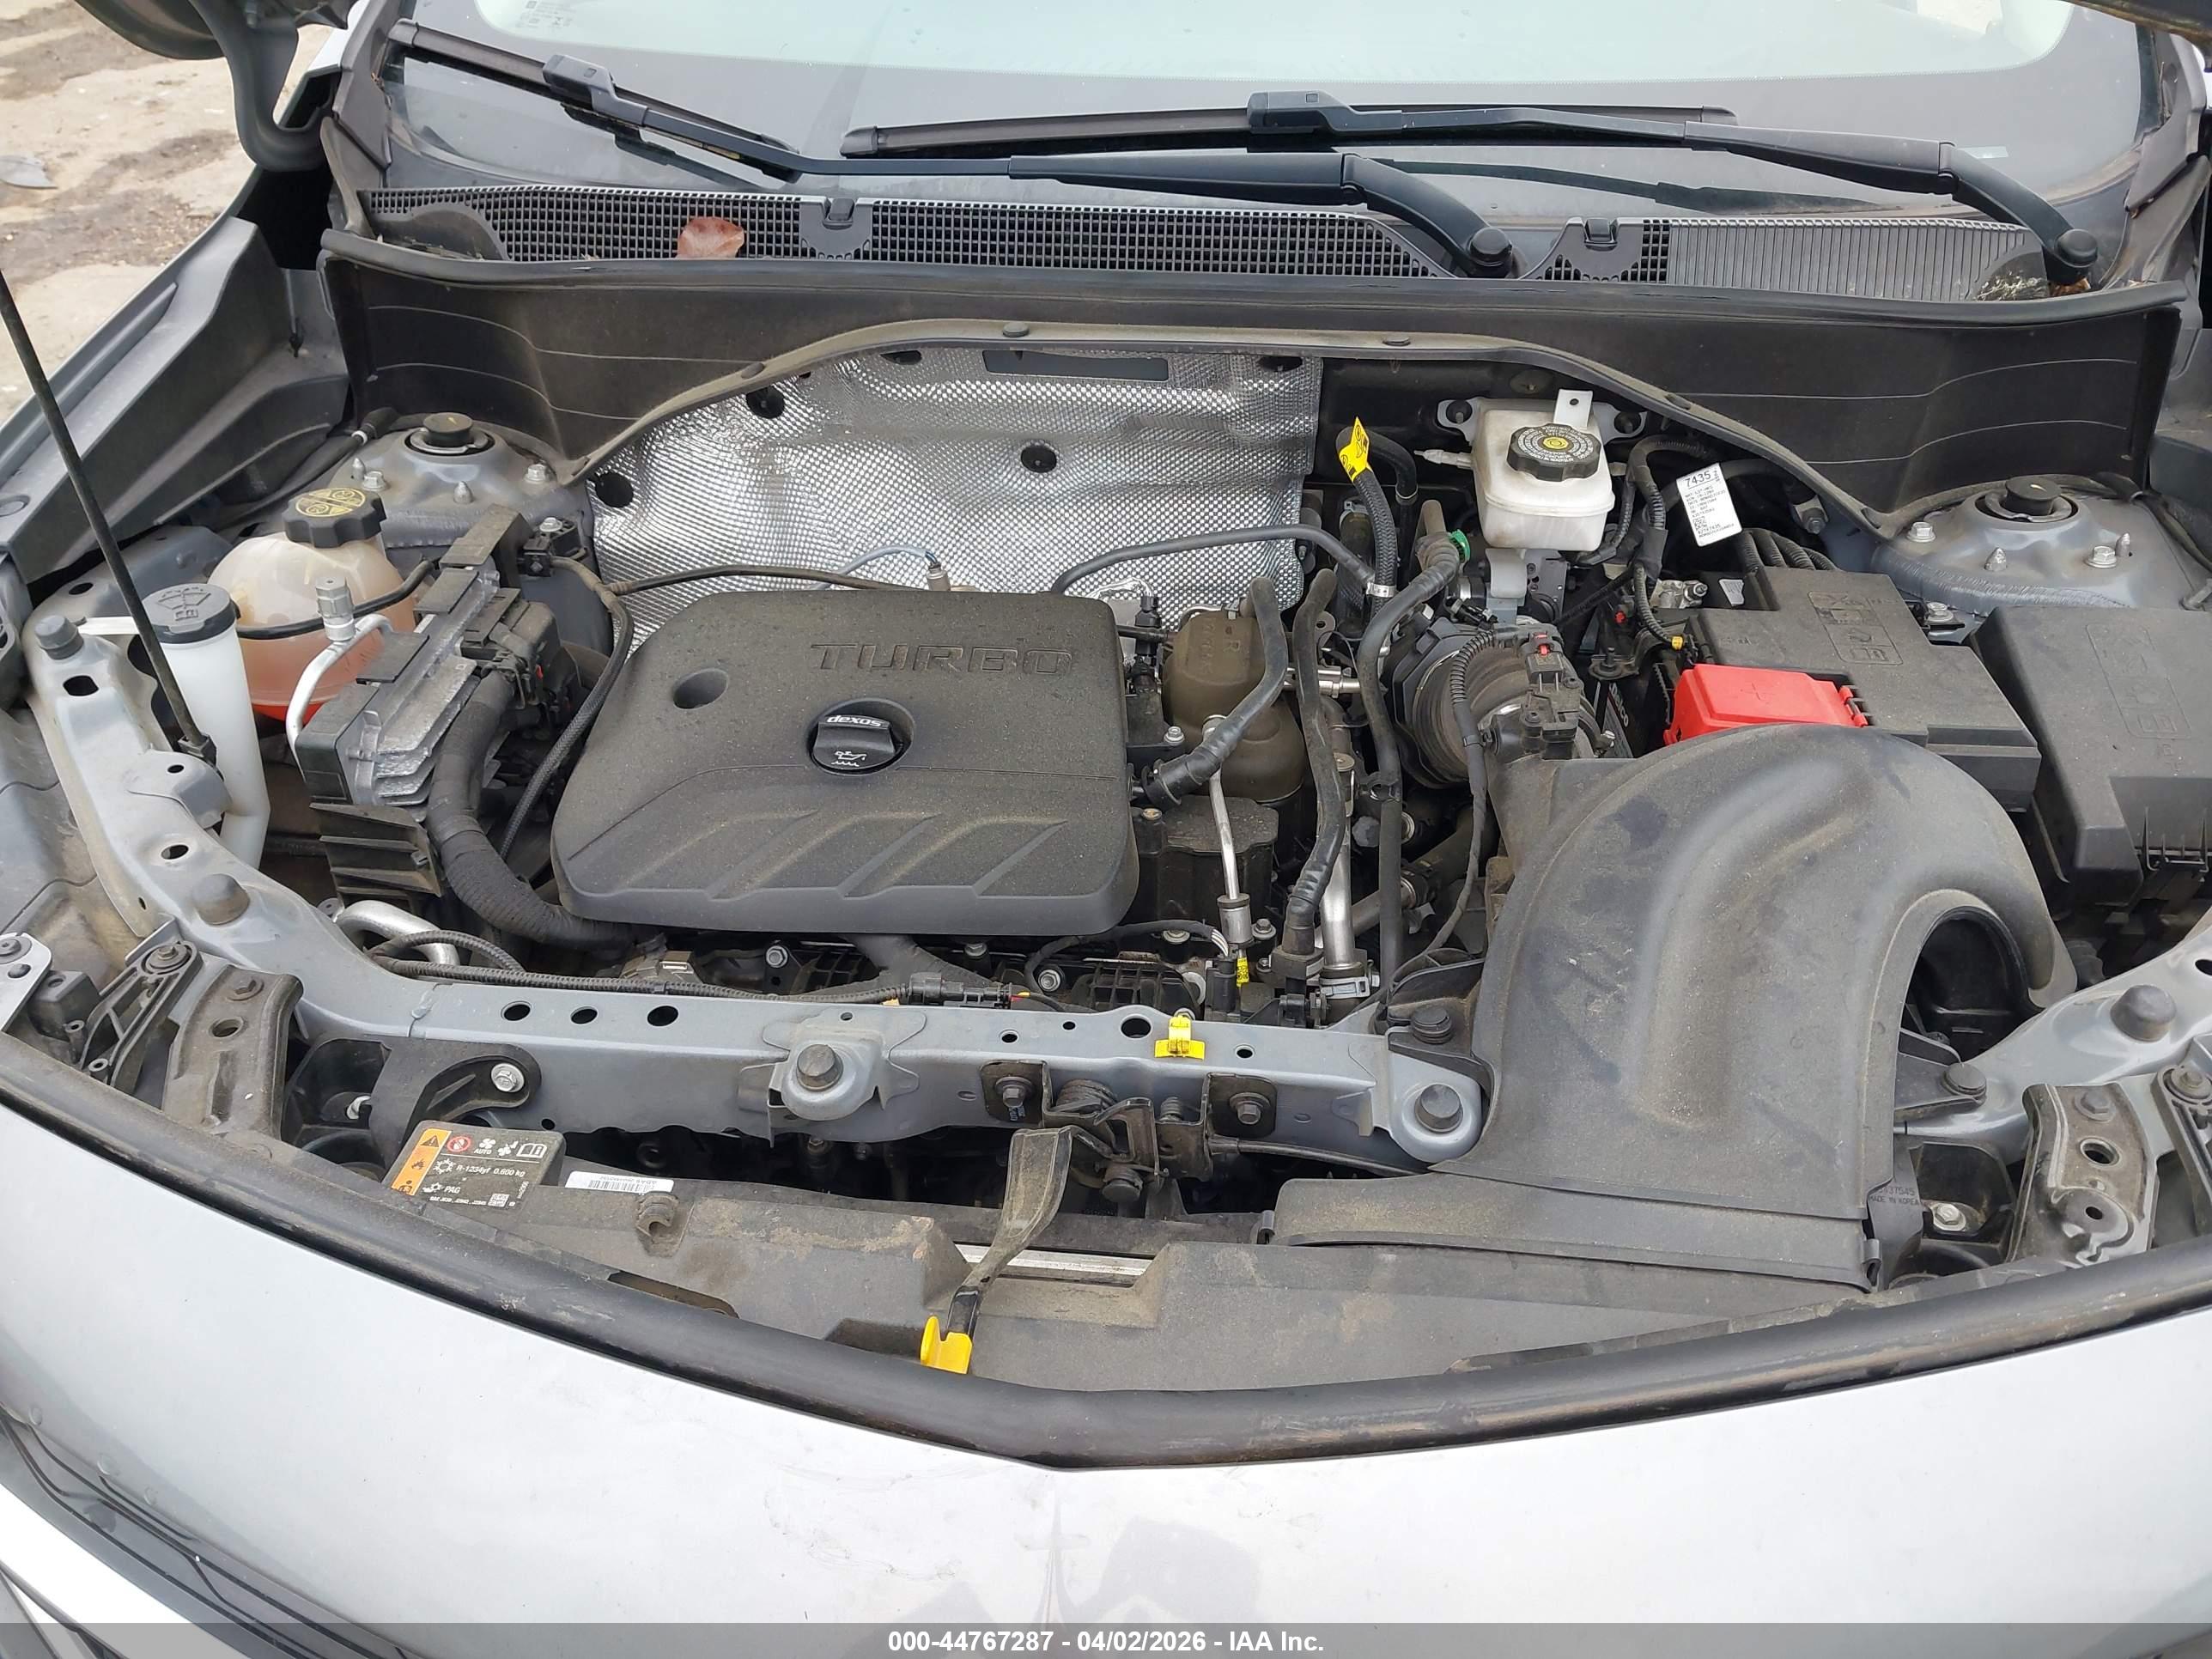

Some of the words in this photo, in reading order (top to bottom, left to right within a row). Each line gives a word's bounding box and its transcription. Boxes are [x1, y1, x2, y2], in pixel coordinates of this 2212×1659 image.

[1685, 471, 1711, 487] 7435
[811, 644, 1073, 674] TURBO
[826, 714, 884, 727] dexos
[455, 1164, 492, 1175] R-1234yf
[493, 1168, 515, 1176] 0.600
[444, 1184, 461, 1194] PAG
